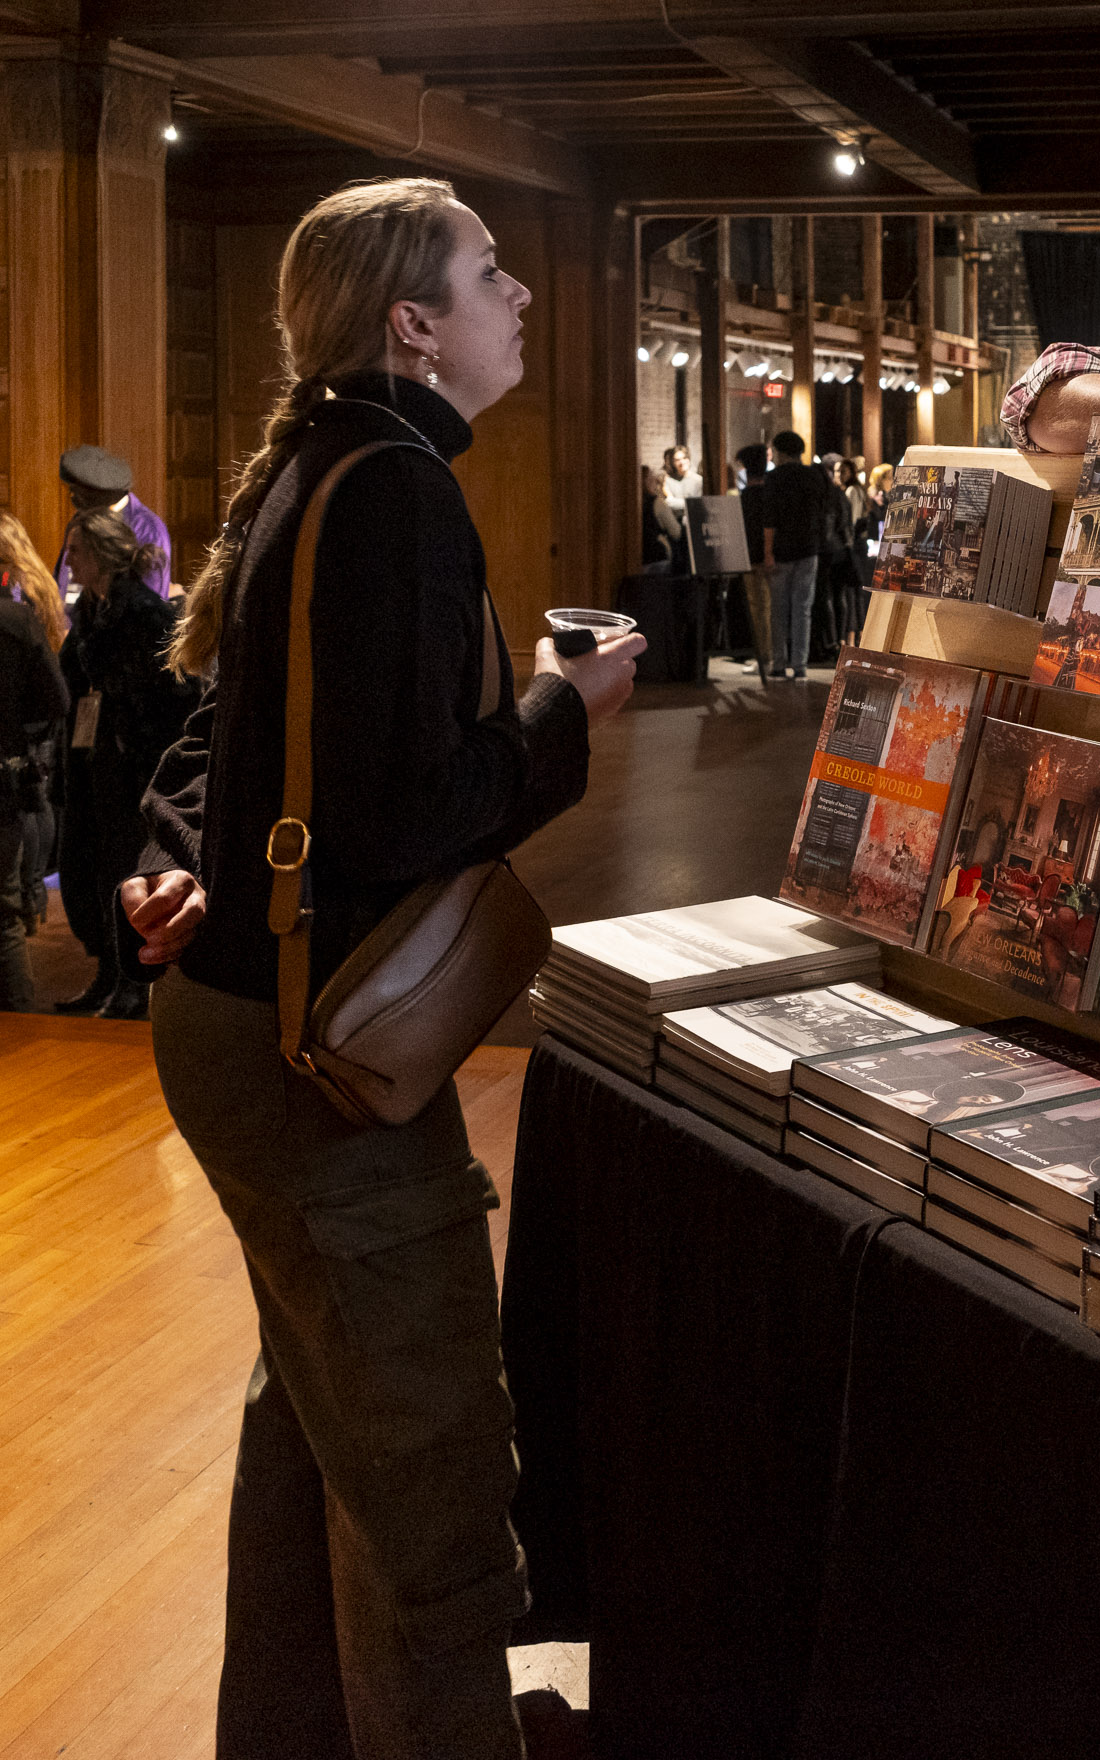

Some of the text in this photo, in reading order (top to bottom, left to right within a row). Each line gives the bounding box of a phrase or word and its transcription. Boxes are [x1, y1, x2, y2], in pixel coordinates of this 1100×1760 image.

[919, 482, 939, 495] NEW
[918, 496, 952, 510] ORLEANS
[826, 761, 923, 800] CREOLE WORLD
[994, 937, 1043, 966] ORLEANS
[1004, 959, 1046, 986] Decadence
[981, 1036, 1038, 1059] Lens
[866, 1076, 898, 1092] Lawrence
[984, 1134, 1004, 1144] John
[1012, 1146, 1050, 1165] Lawrence
